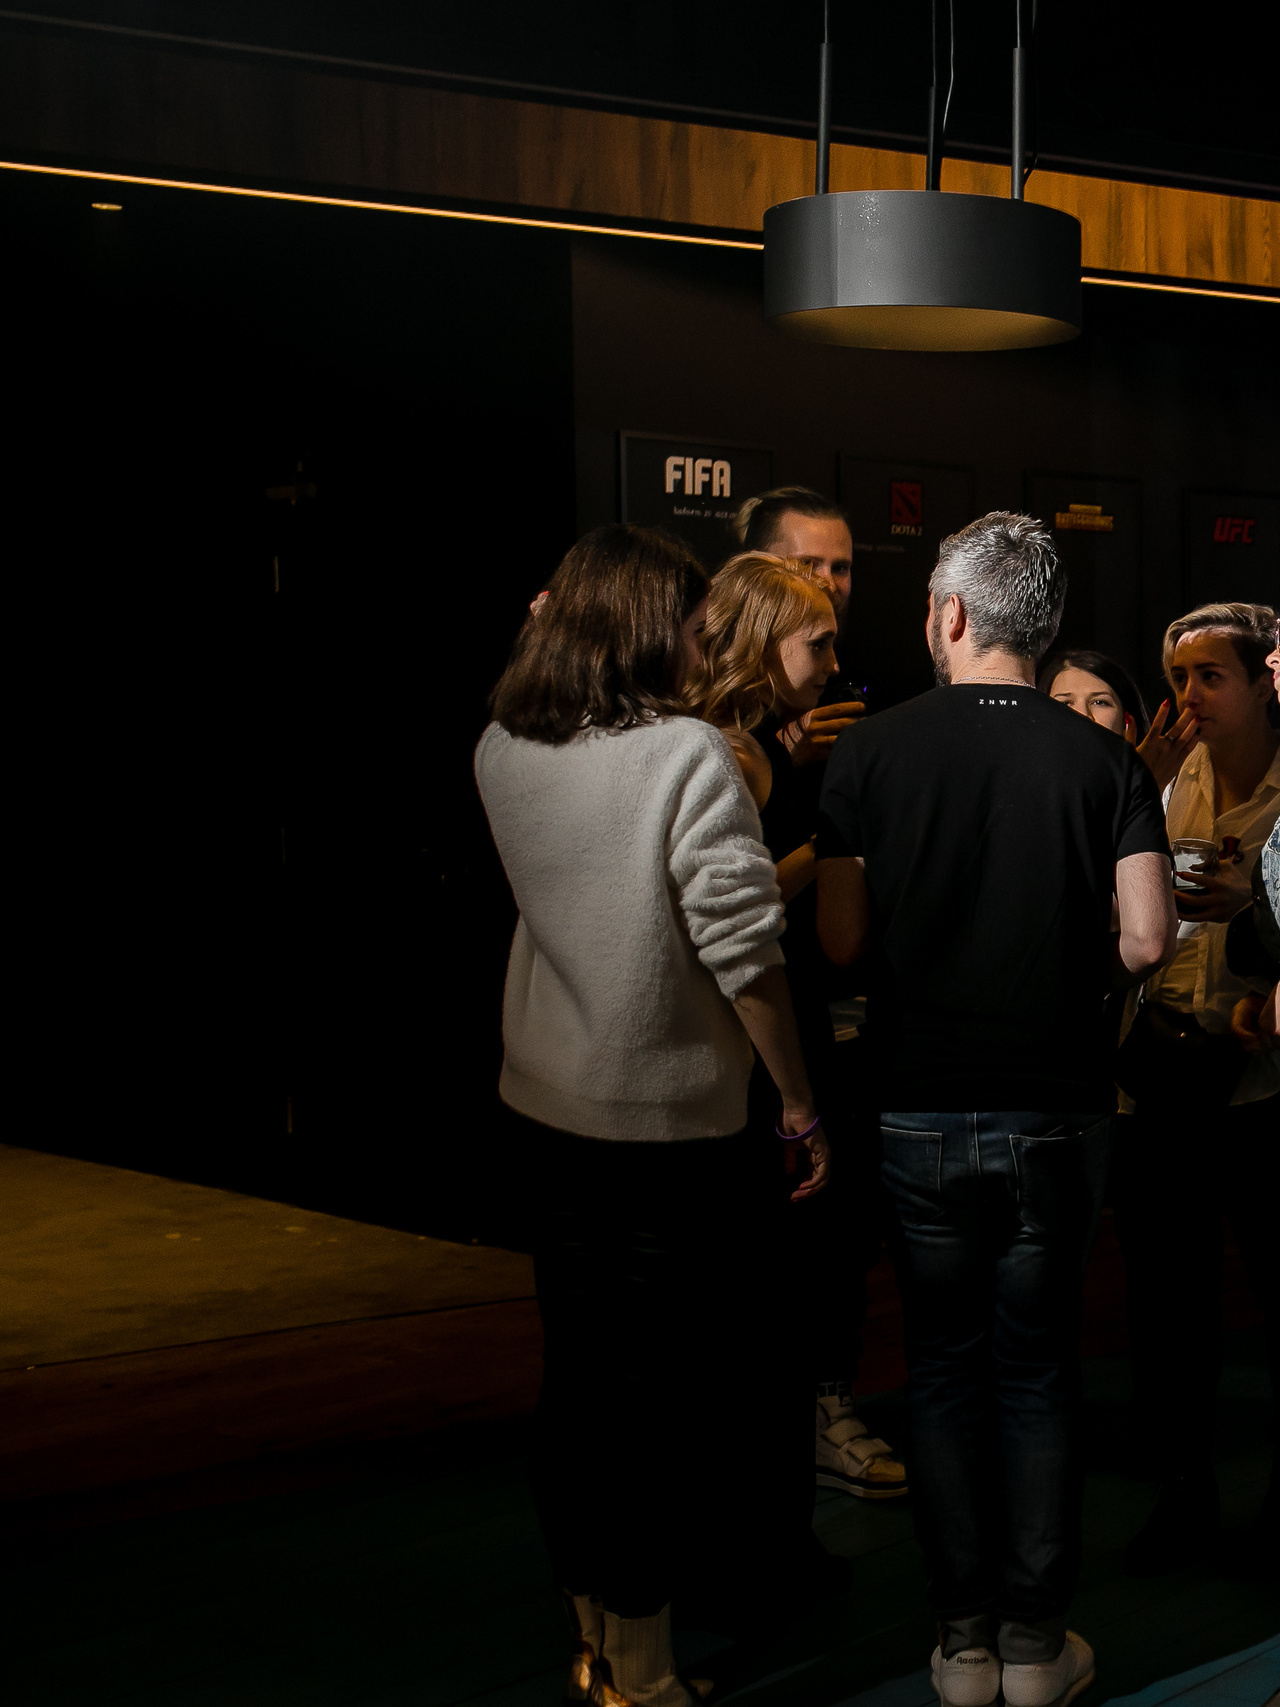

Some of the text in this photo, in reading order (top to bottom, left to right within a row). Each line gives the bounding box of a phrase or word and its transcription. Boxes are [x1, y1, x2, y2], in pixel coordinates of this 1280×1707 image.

[665, 455, 731, 498] FIFA
[1213, 517, 1256, 544] UFC
[978, 698, 1018, 706] ZNWR
[956, 1655, 989, 1665] Reebok
